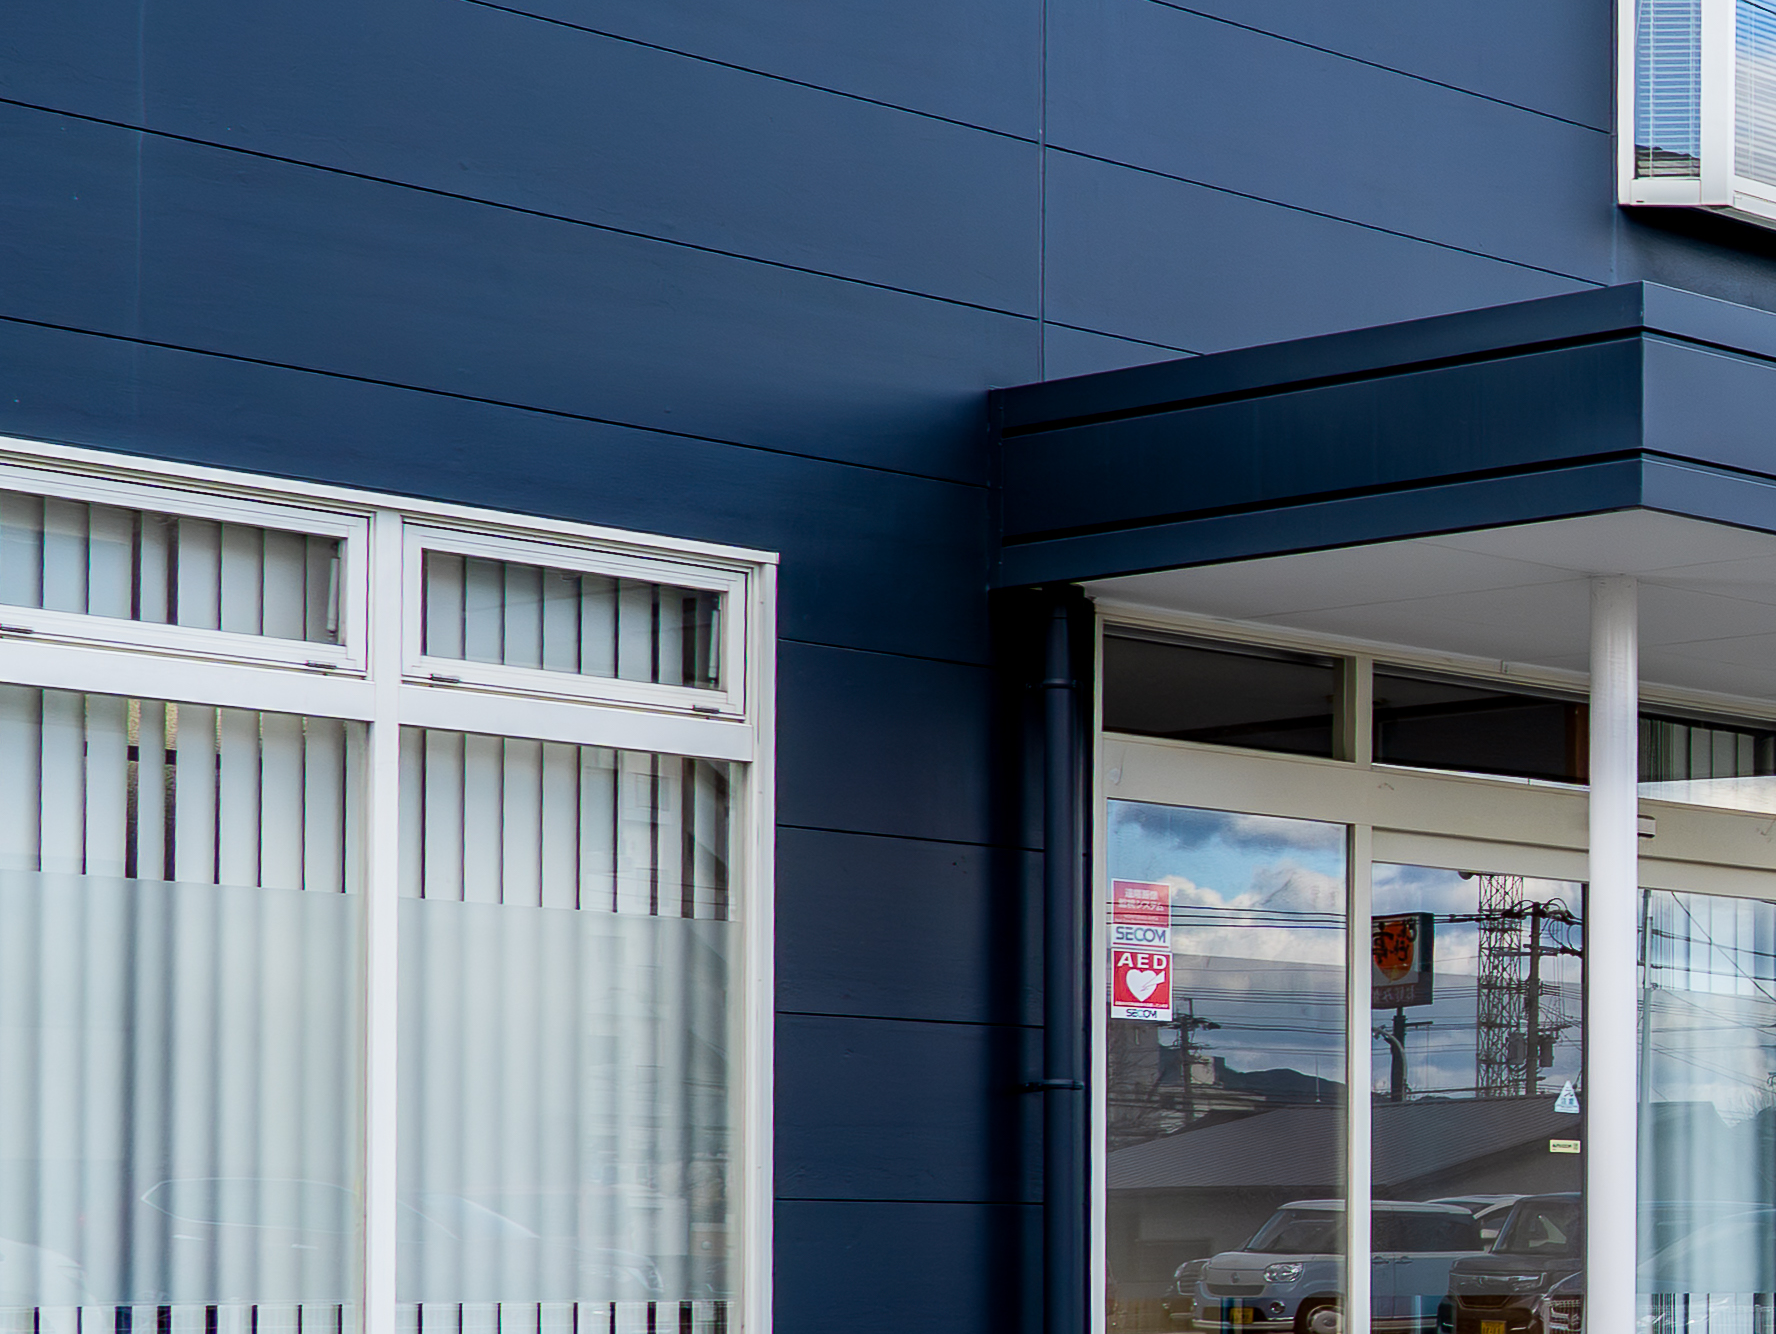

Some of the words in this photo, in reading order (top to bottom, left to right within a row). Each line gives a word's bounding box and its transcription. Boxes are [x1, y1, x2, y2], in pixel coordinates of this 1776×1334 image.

[1116, 926, 1166, 943] SECOM
[1117, 952, 1167, 970] AED
[1126, 1008, 1158, 1019] SECOM
